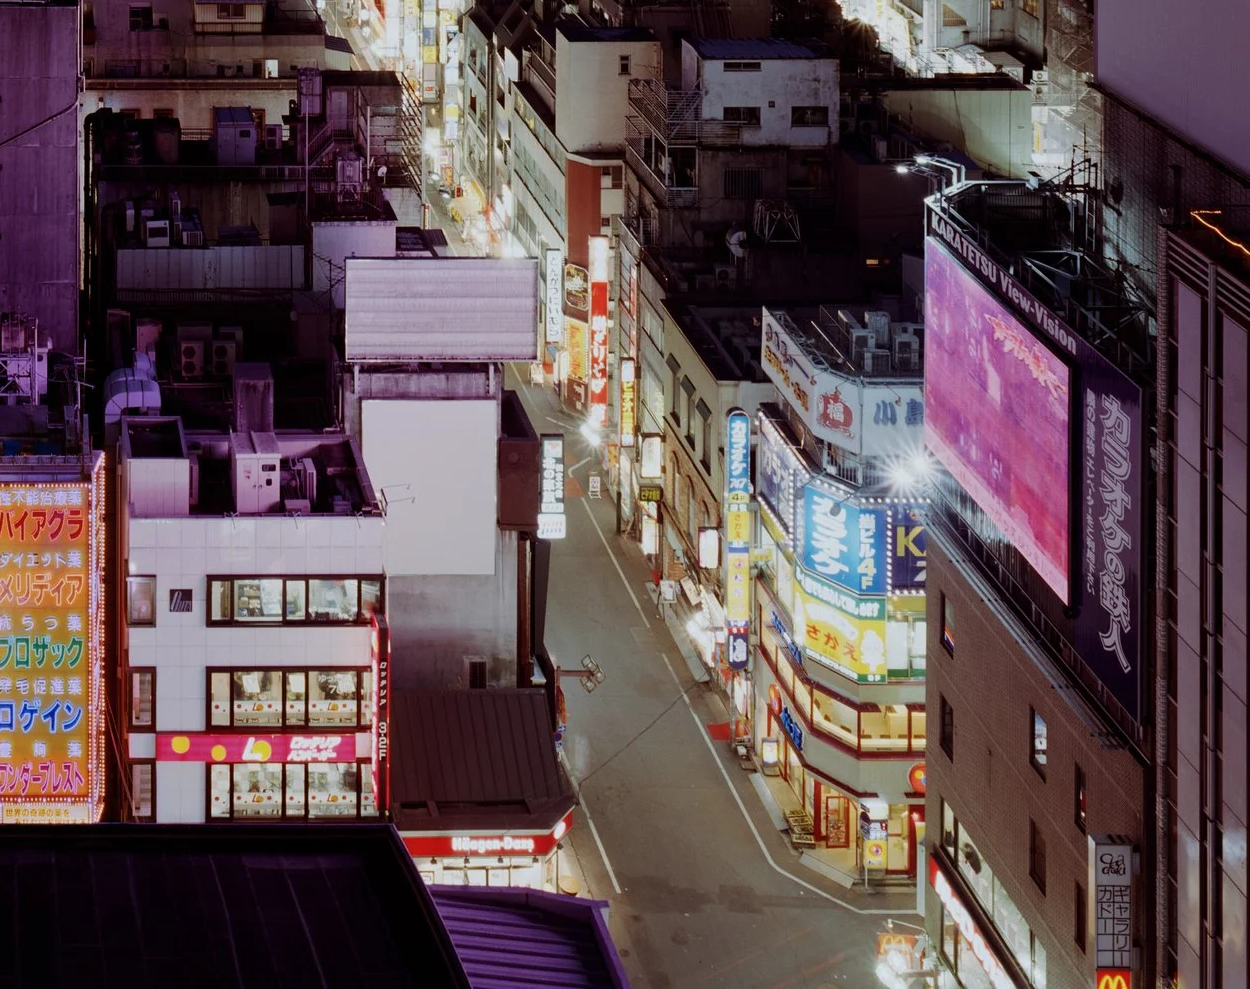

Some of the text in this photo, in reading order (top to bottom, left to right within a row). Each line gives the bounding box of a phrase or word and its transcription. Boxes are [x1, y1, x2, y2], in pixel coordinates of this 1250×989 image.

[931, 210, 998, 284] KARATETSU
[999, 270, 1077, 356] View-Vision
[1098, 393, 1132, 674] カラオケの鉄人
[806, 623, 860, 662] さかえ
[379, 661, 388, 707] ロッテリア
[287, 750, 337, 761] ハンバーガー
[290, 736, 342, 750] ロッテリア
[451, 837, 535, 853] Häagen-Dazs
[1098, 889, 1112, 933] カドー
[1114, 887, 1129, 966] ギャラリー
